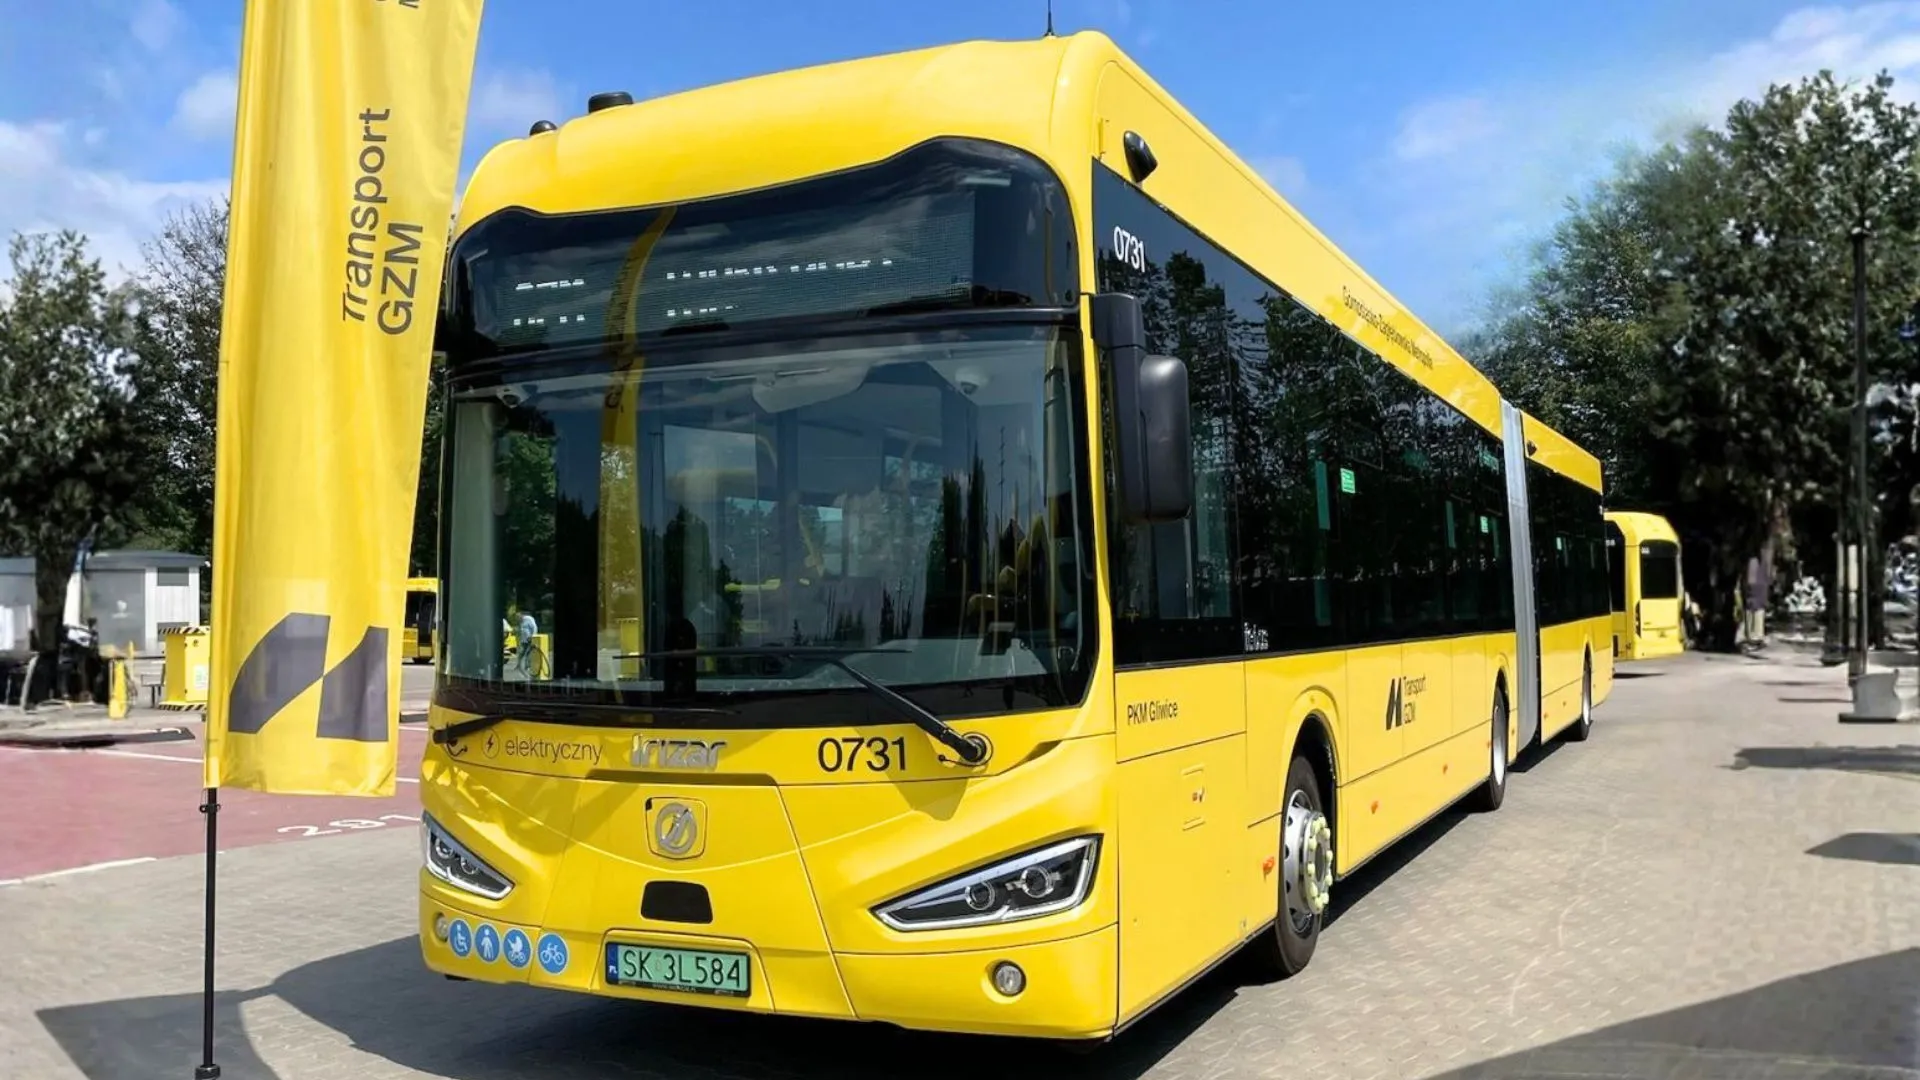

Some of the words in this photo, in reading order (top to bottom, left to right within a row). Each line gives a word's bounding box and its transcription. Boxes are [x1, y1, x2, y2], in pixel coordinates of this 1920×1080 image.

[341, 107, 391, 322] Transport
[1113, 226, 1146, 273] 0731
[376, 222, 424, 336] GZM
[1127, 702, 1148, 726] PKM
[1149, 699, 1178, 722] Gliwice
[505, 735, 603, 764] elektryczny
[818, 736, 907, 773] 0731
[623, 949, 652, 980] SK
[663, 953, 741, 988] 3L584
